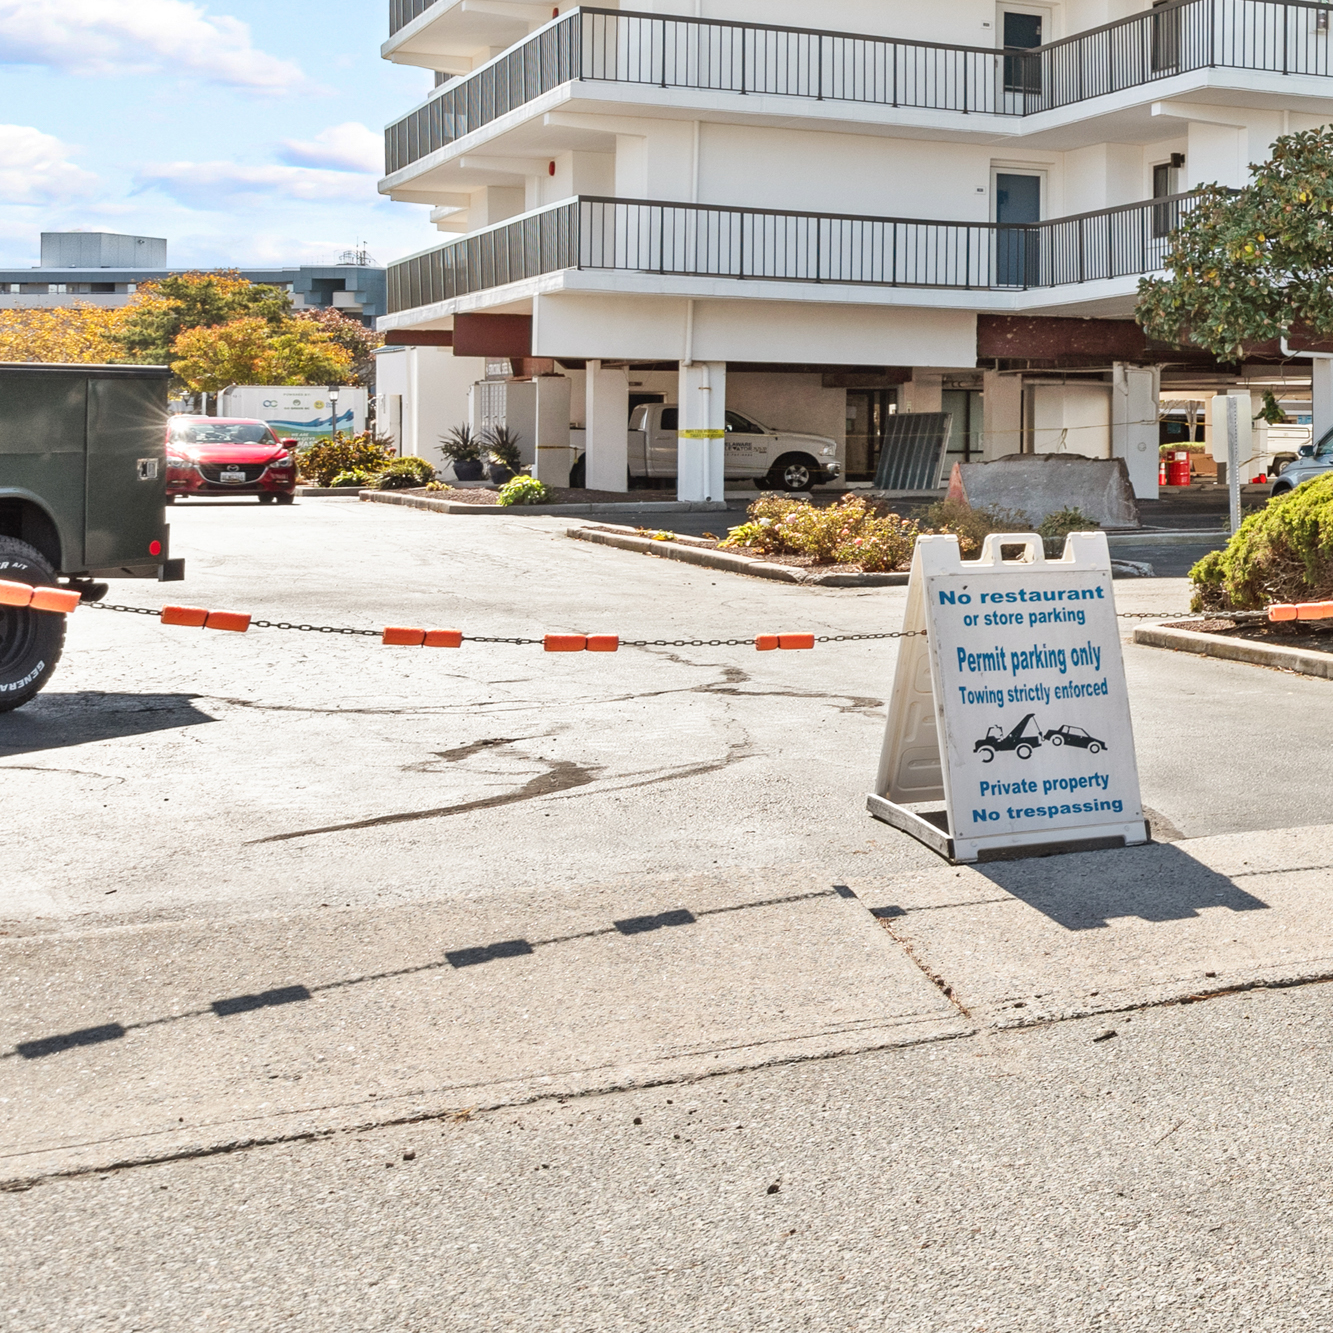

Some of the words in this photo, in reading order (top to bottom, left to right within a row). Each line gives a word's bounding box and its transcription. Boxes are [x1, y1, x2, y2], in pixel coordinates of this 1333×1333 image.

[939, 590, 972, 605] No
[980, 586, 1105, 604] restaurant
[963, 614, 979, 626] or
[984, 611, 1024, 626] store
[1029, 607, 1086, 627] parking
[957, 646, 1008, 672] Permit
[1010, 643, 1067, 676] parking
[1070, 640, 1101, 671] only
[0, 659, 46, 692] GENERA
[959, 686, 1004, 708] Towing
[1008, 682, 1050, 705] strictly
[1054, 677, 1108, 700] enforced
[979, 778, 1038, 797] Private
[1043, 772, 1110, 796] property
[972, 809, 1001, 823] No
[1006, 798, 1124, 820] trespassing
